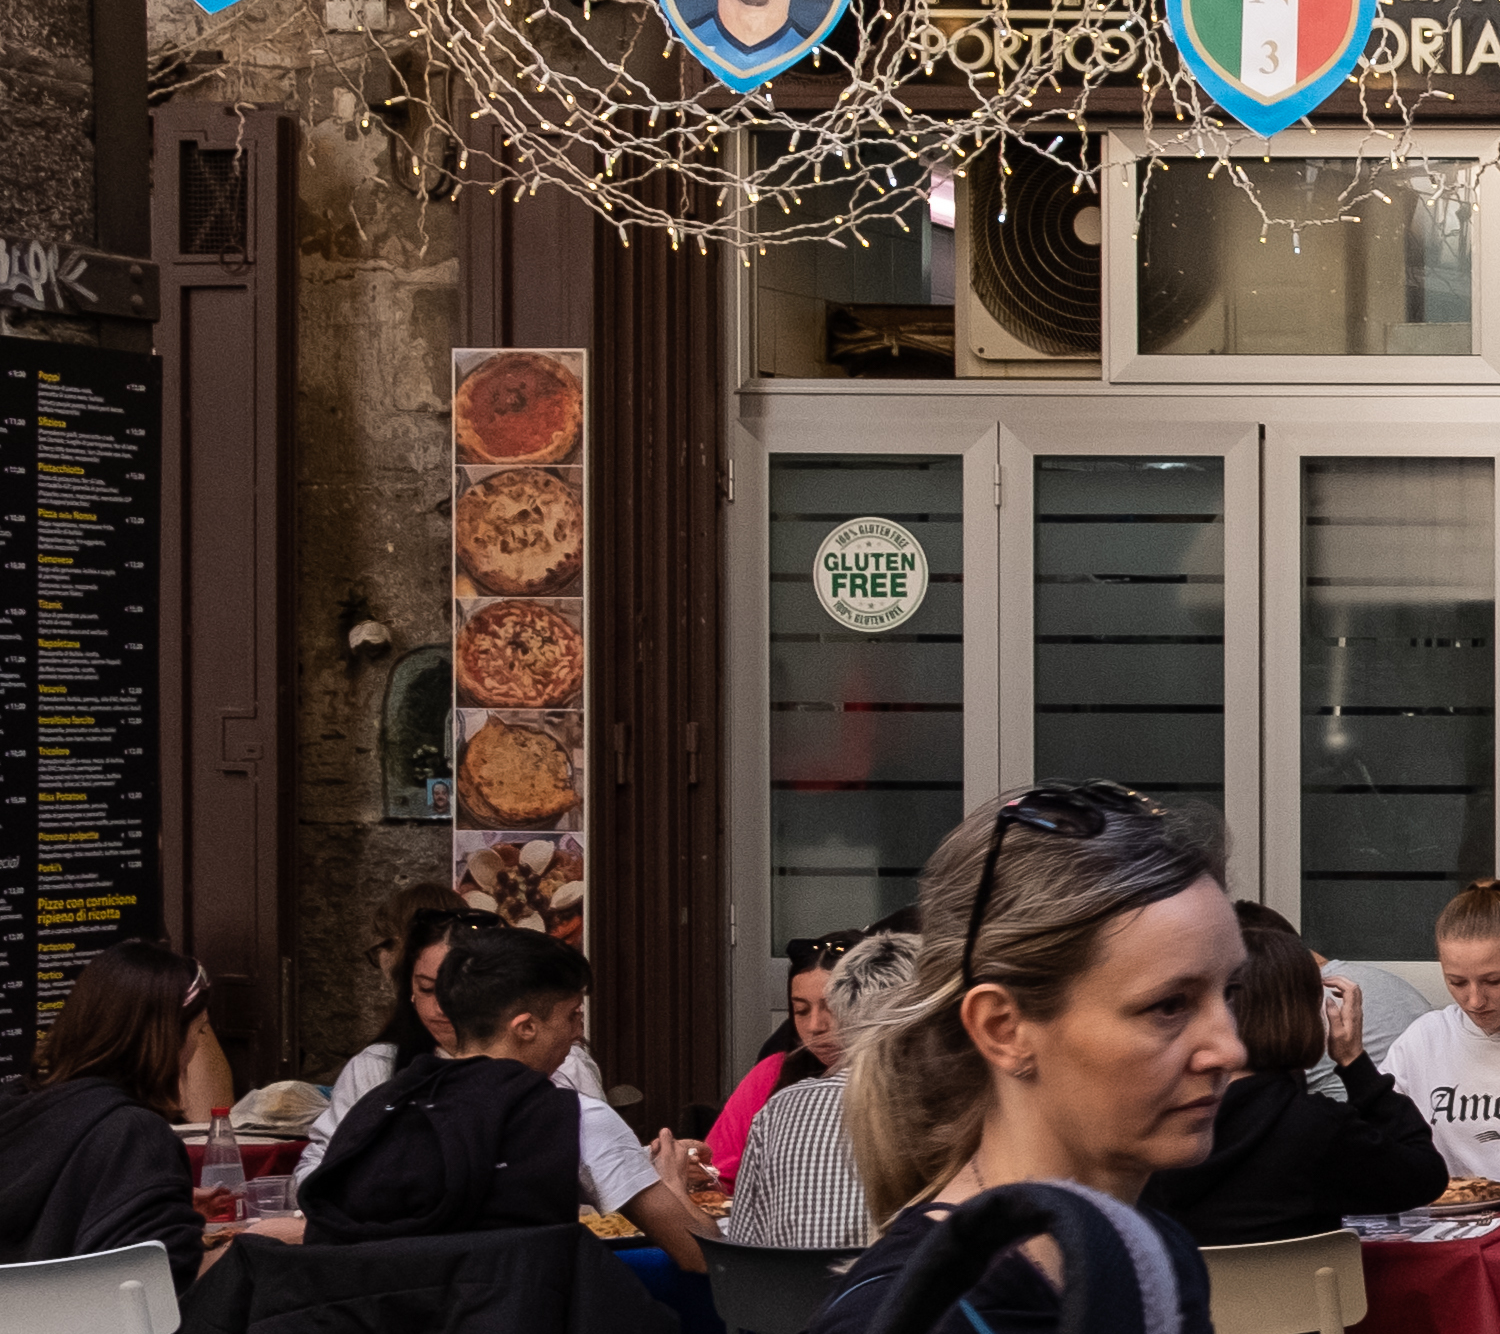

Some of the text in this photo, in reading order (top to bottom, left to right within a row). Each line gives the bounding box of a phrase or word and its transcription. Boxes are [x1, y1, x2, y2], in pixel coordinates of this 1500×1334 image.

[1259, 40, 1281, 75] 3
[858, 524, 891, 538] GLUTEN
[889, 530, 910, 550] FREE
[823, 552, 916, 572] GLUTEN
[831, 572, 908, 598] FREE
[38, 893, 137, 911] Pizze con cornicione
[37, 907, 121, 927] ripieno di ricotta
